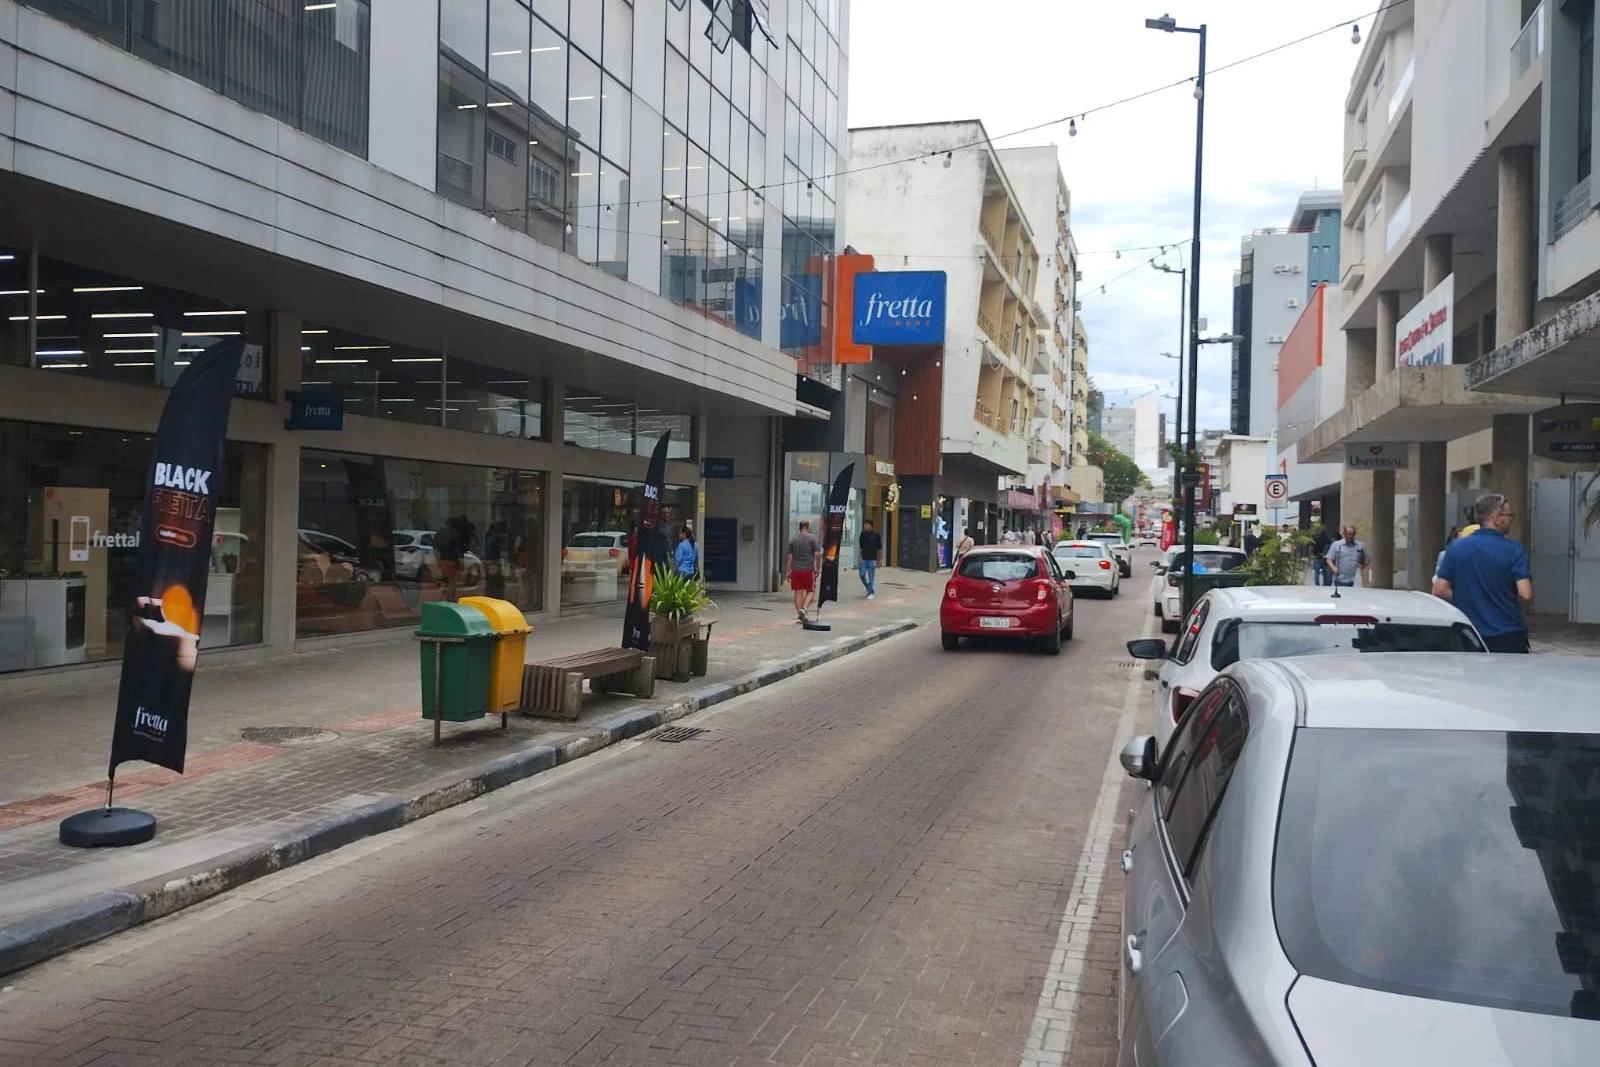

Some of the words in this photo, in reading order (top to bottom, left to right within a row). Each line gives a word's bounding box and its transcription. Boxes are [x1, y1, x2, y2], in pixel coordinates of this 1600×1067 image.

[859, 292, 933, 326] fretta
[154, 462, 212, 495] BLACK
[1273, 484, 1280, 495] E
